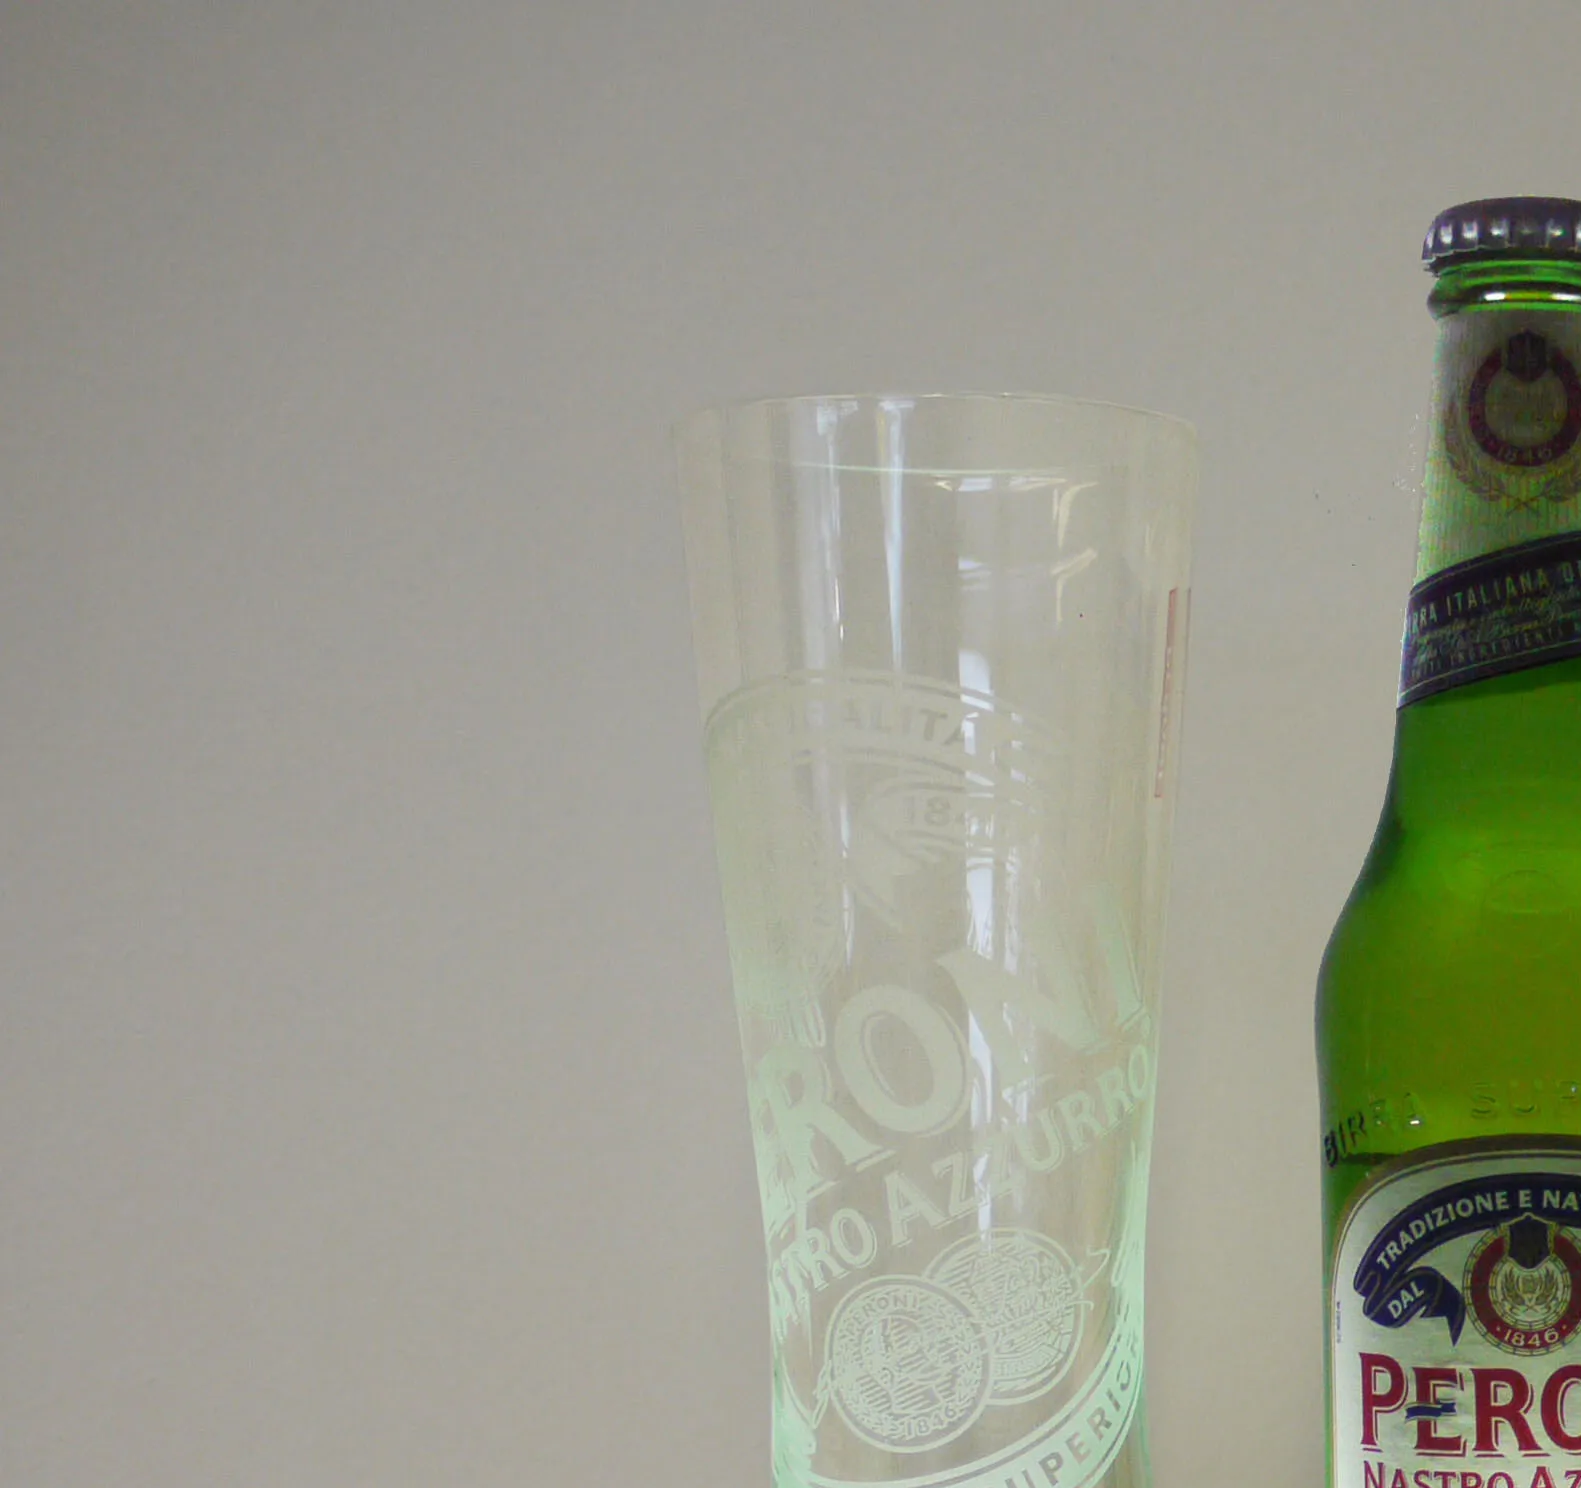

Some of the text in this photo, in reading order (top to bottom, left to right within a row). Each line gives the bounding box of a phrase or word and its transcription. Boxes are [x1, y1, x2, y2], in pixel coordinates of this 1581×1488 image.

[1446, 568, 1549, 616] ITALIANA
[1376, 1191, 1509, 1270] TRADIZIONE
[1519, 1188, 1533, 1208] E
[1388, 1284, 1425, 1320] DAL
[1503, 1325, 1560, 1349] 1846
